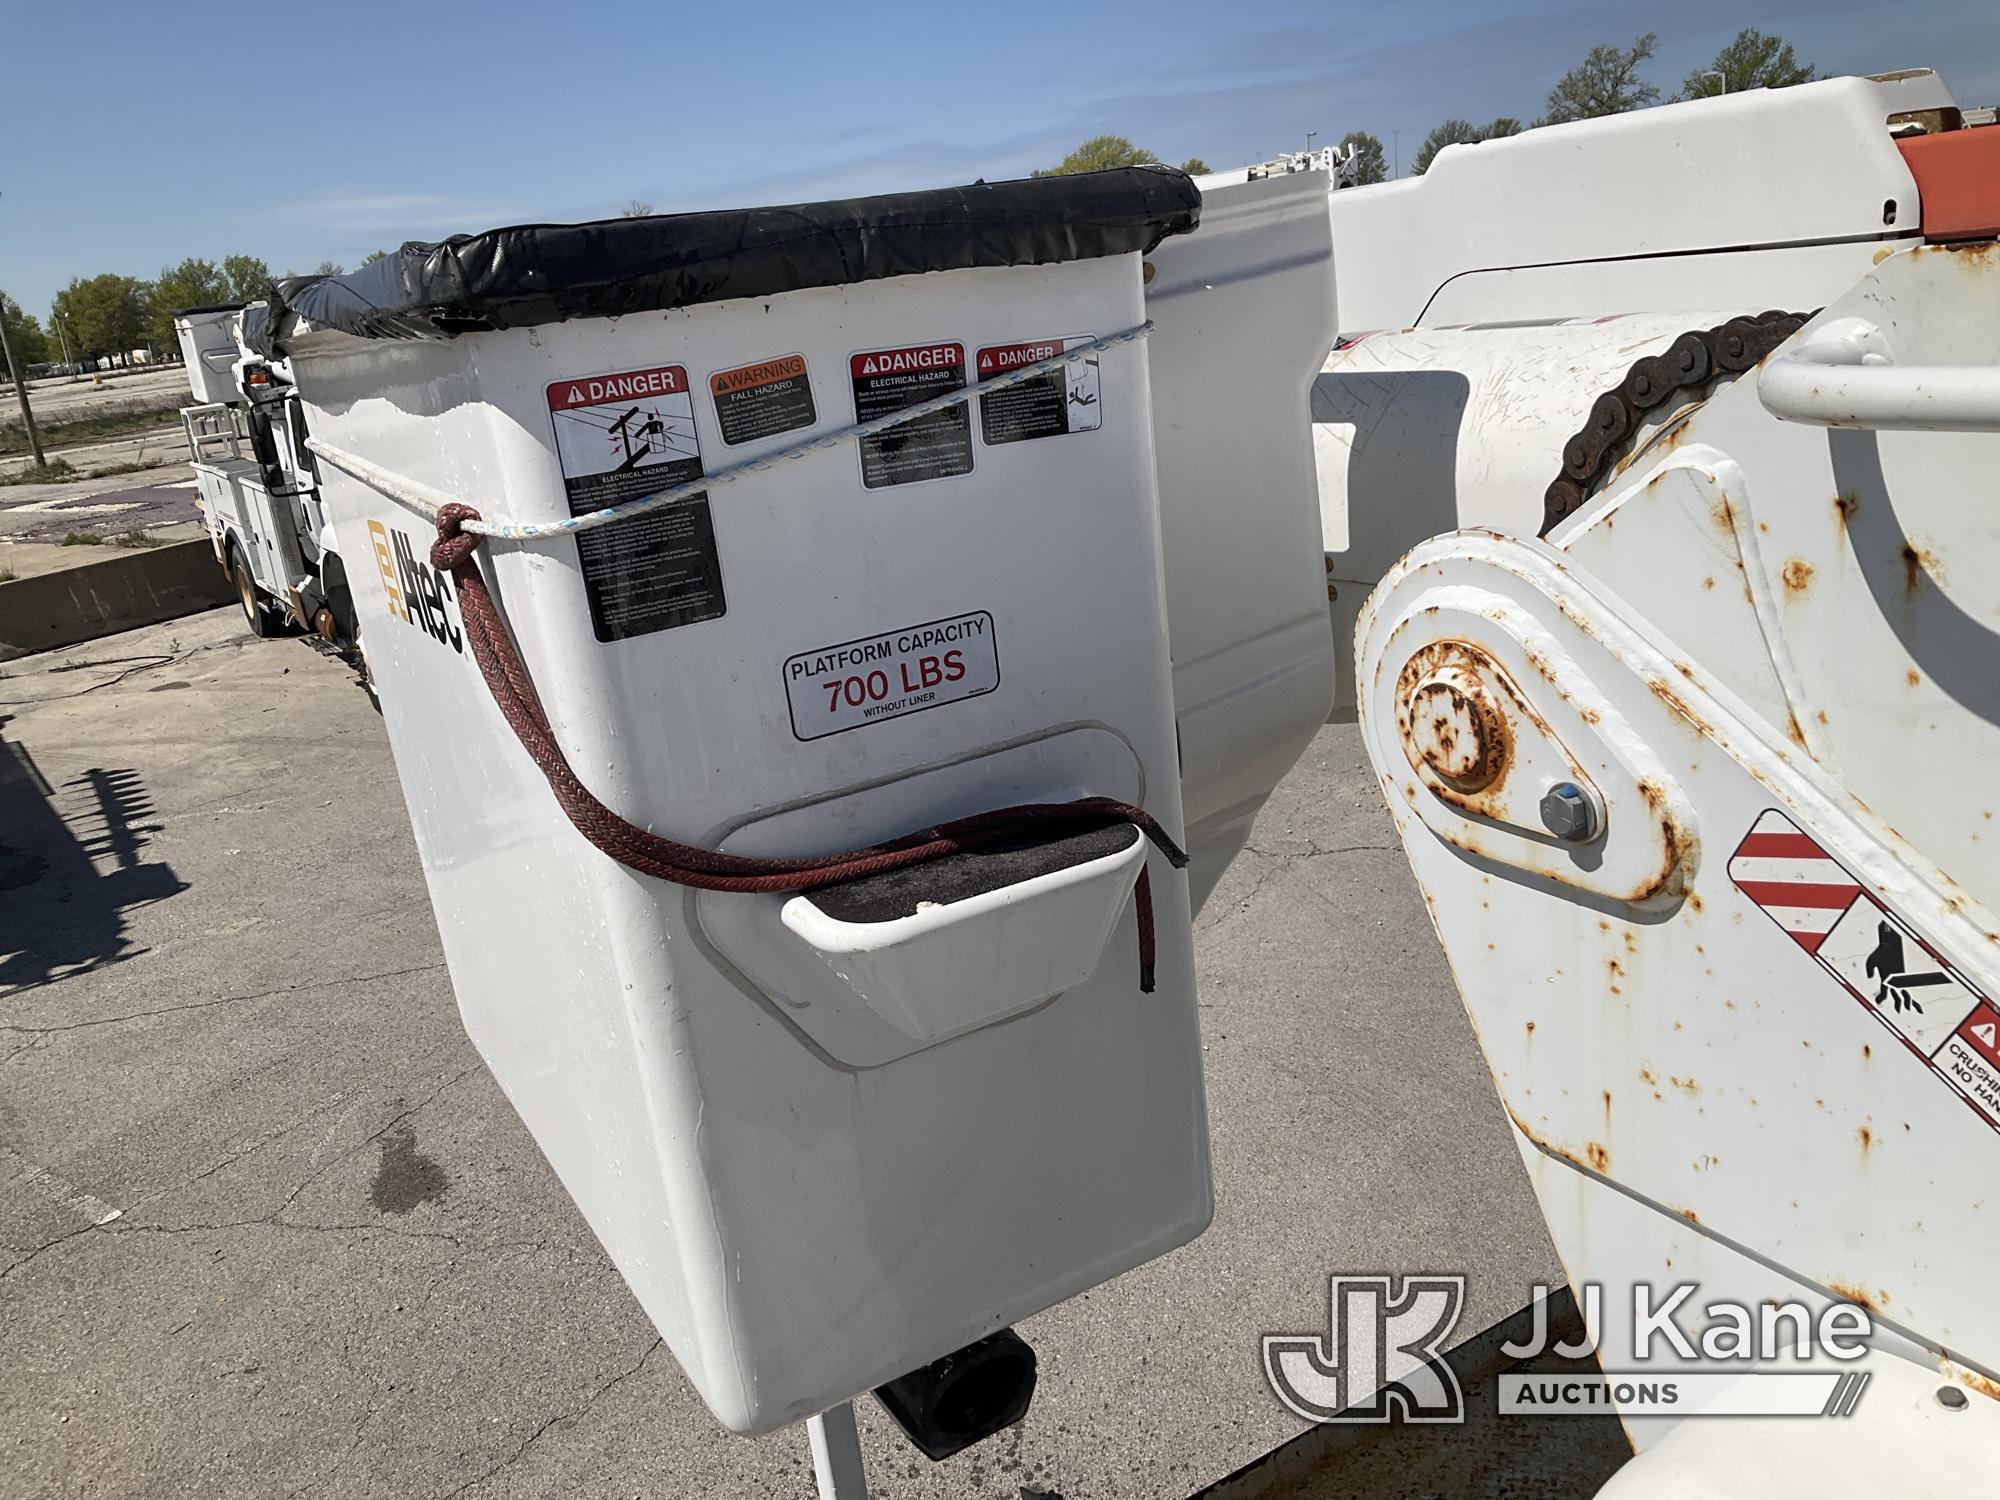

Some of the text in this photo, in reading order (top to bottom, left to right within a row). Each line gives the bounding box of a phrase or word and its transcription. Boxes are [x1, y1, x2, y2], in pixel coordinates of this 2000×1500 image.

[879, 348, 957, 372] DANGER
[999, 346, 1054, 365] DANGER
[728, 359, 801, 386] WARNING
[870, 370, 950, 388] ELECTRICAL HAZARD
[589, 371, 675, 400] DANGER
[731, 380, 793, 402] FALL HAZARD
[602, 466, 669, 483] ELECTRICAL HAZARD
[791, 617, 985, 680] PLATFORM CAPACITY
[823, 650, 966, 712] 700 LBS
[863, 691, 936, 718] WITHOUT LINER
[1951, 1062, 1973, 1083] NO
